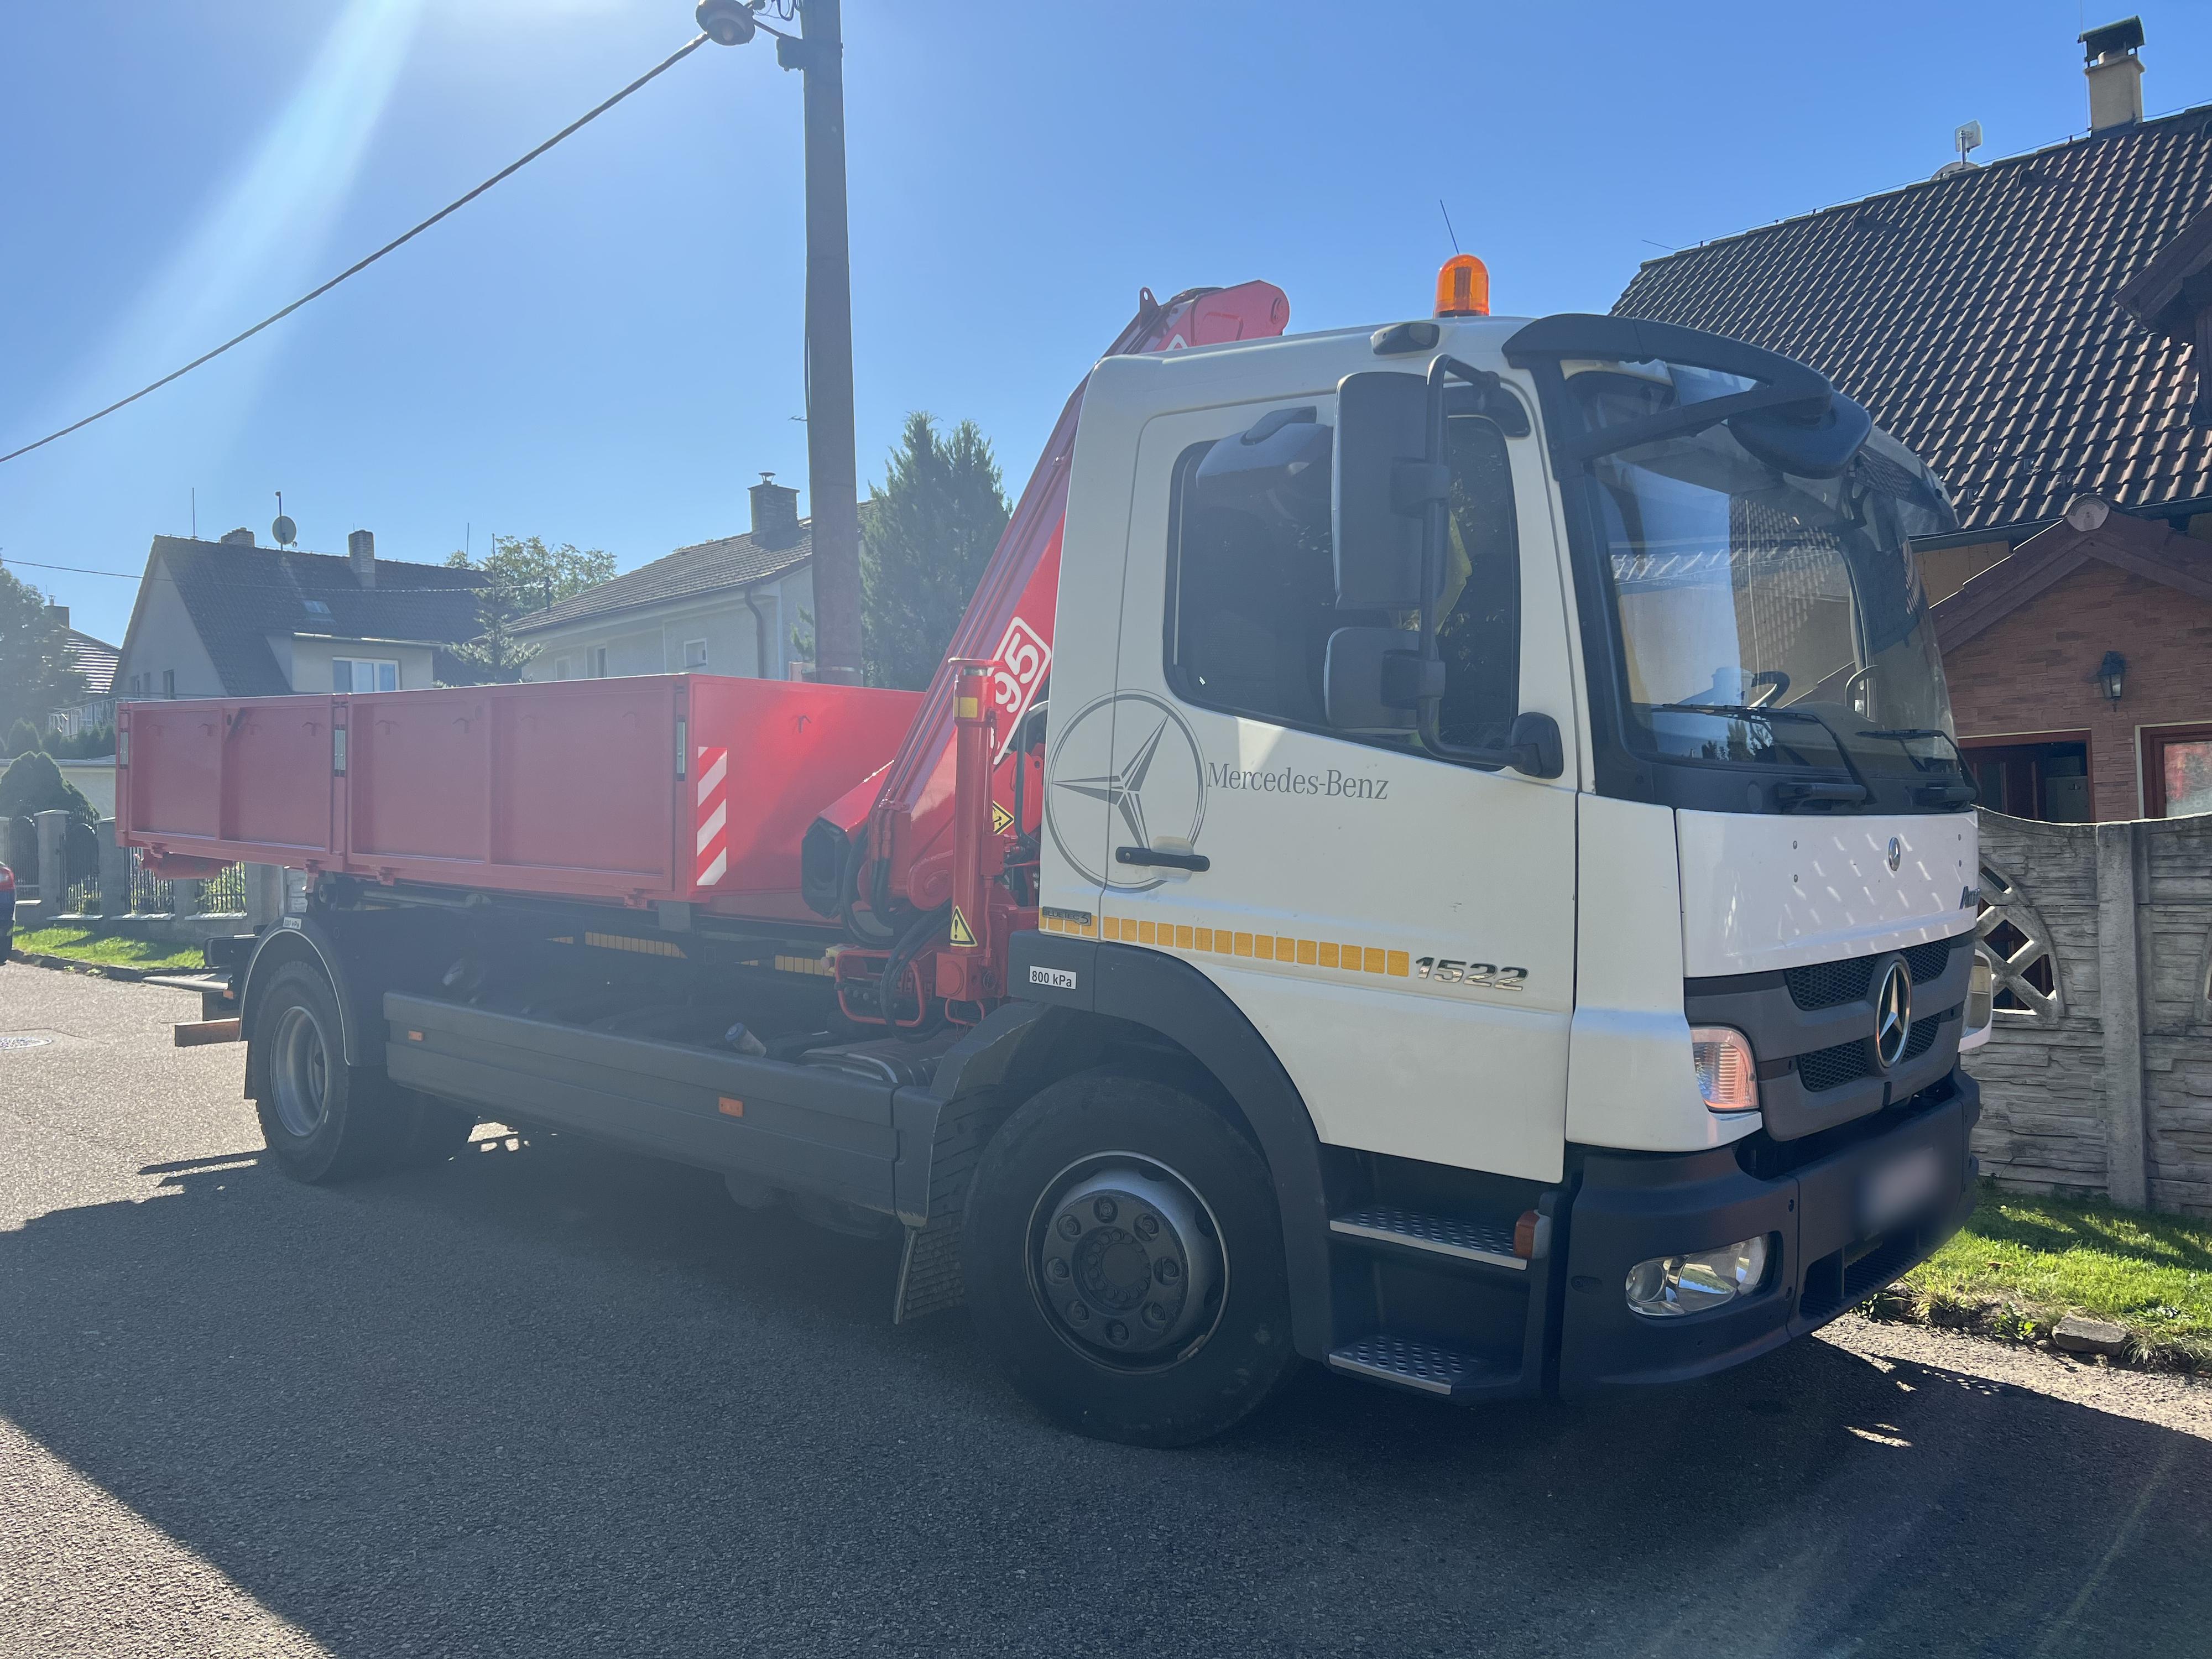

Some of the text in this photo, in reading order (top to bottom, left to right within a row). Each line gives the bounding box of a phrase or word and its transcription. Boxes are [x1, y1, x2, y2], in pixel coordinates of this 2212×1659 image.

[1207, 762, 1389, 800] Mercedes-Benz
[1032, 971, 1072, 987] 800 kPa
[1415, 957, 1528, 991] 1522
